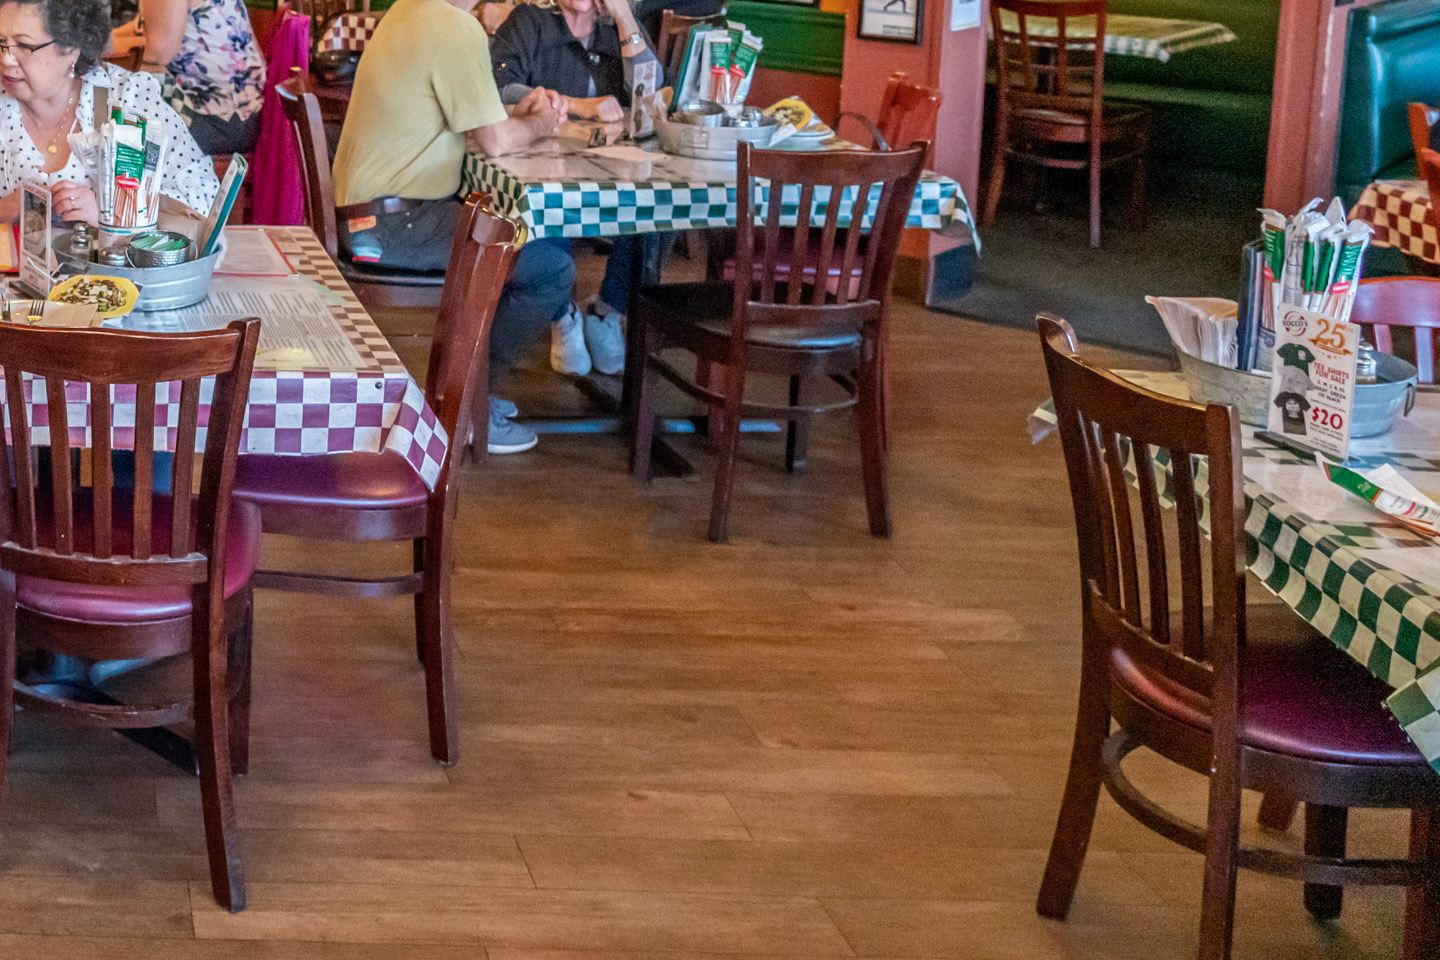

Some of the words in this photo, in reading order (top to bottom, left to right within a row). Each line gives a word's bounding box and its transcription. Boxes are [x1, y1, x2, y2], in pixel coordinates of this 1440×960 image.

[1315, 318, 1347, 349] 25
[1313, 361, 1325, 373] TEE
[1327, 366, 1350, 379] SHIRTS
[1315, 369, 1329, 379] FOR
[1331, 374, 1346, 385] SALE
[1312, 406, 1343, 430] $20
